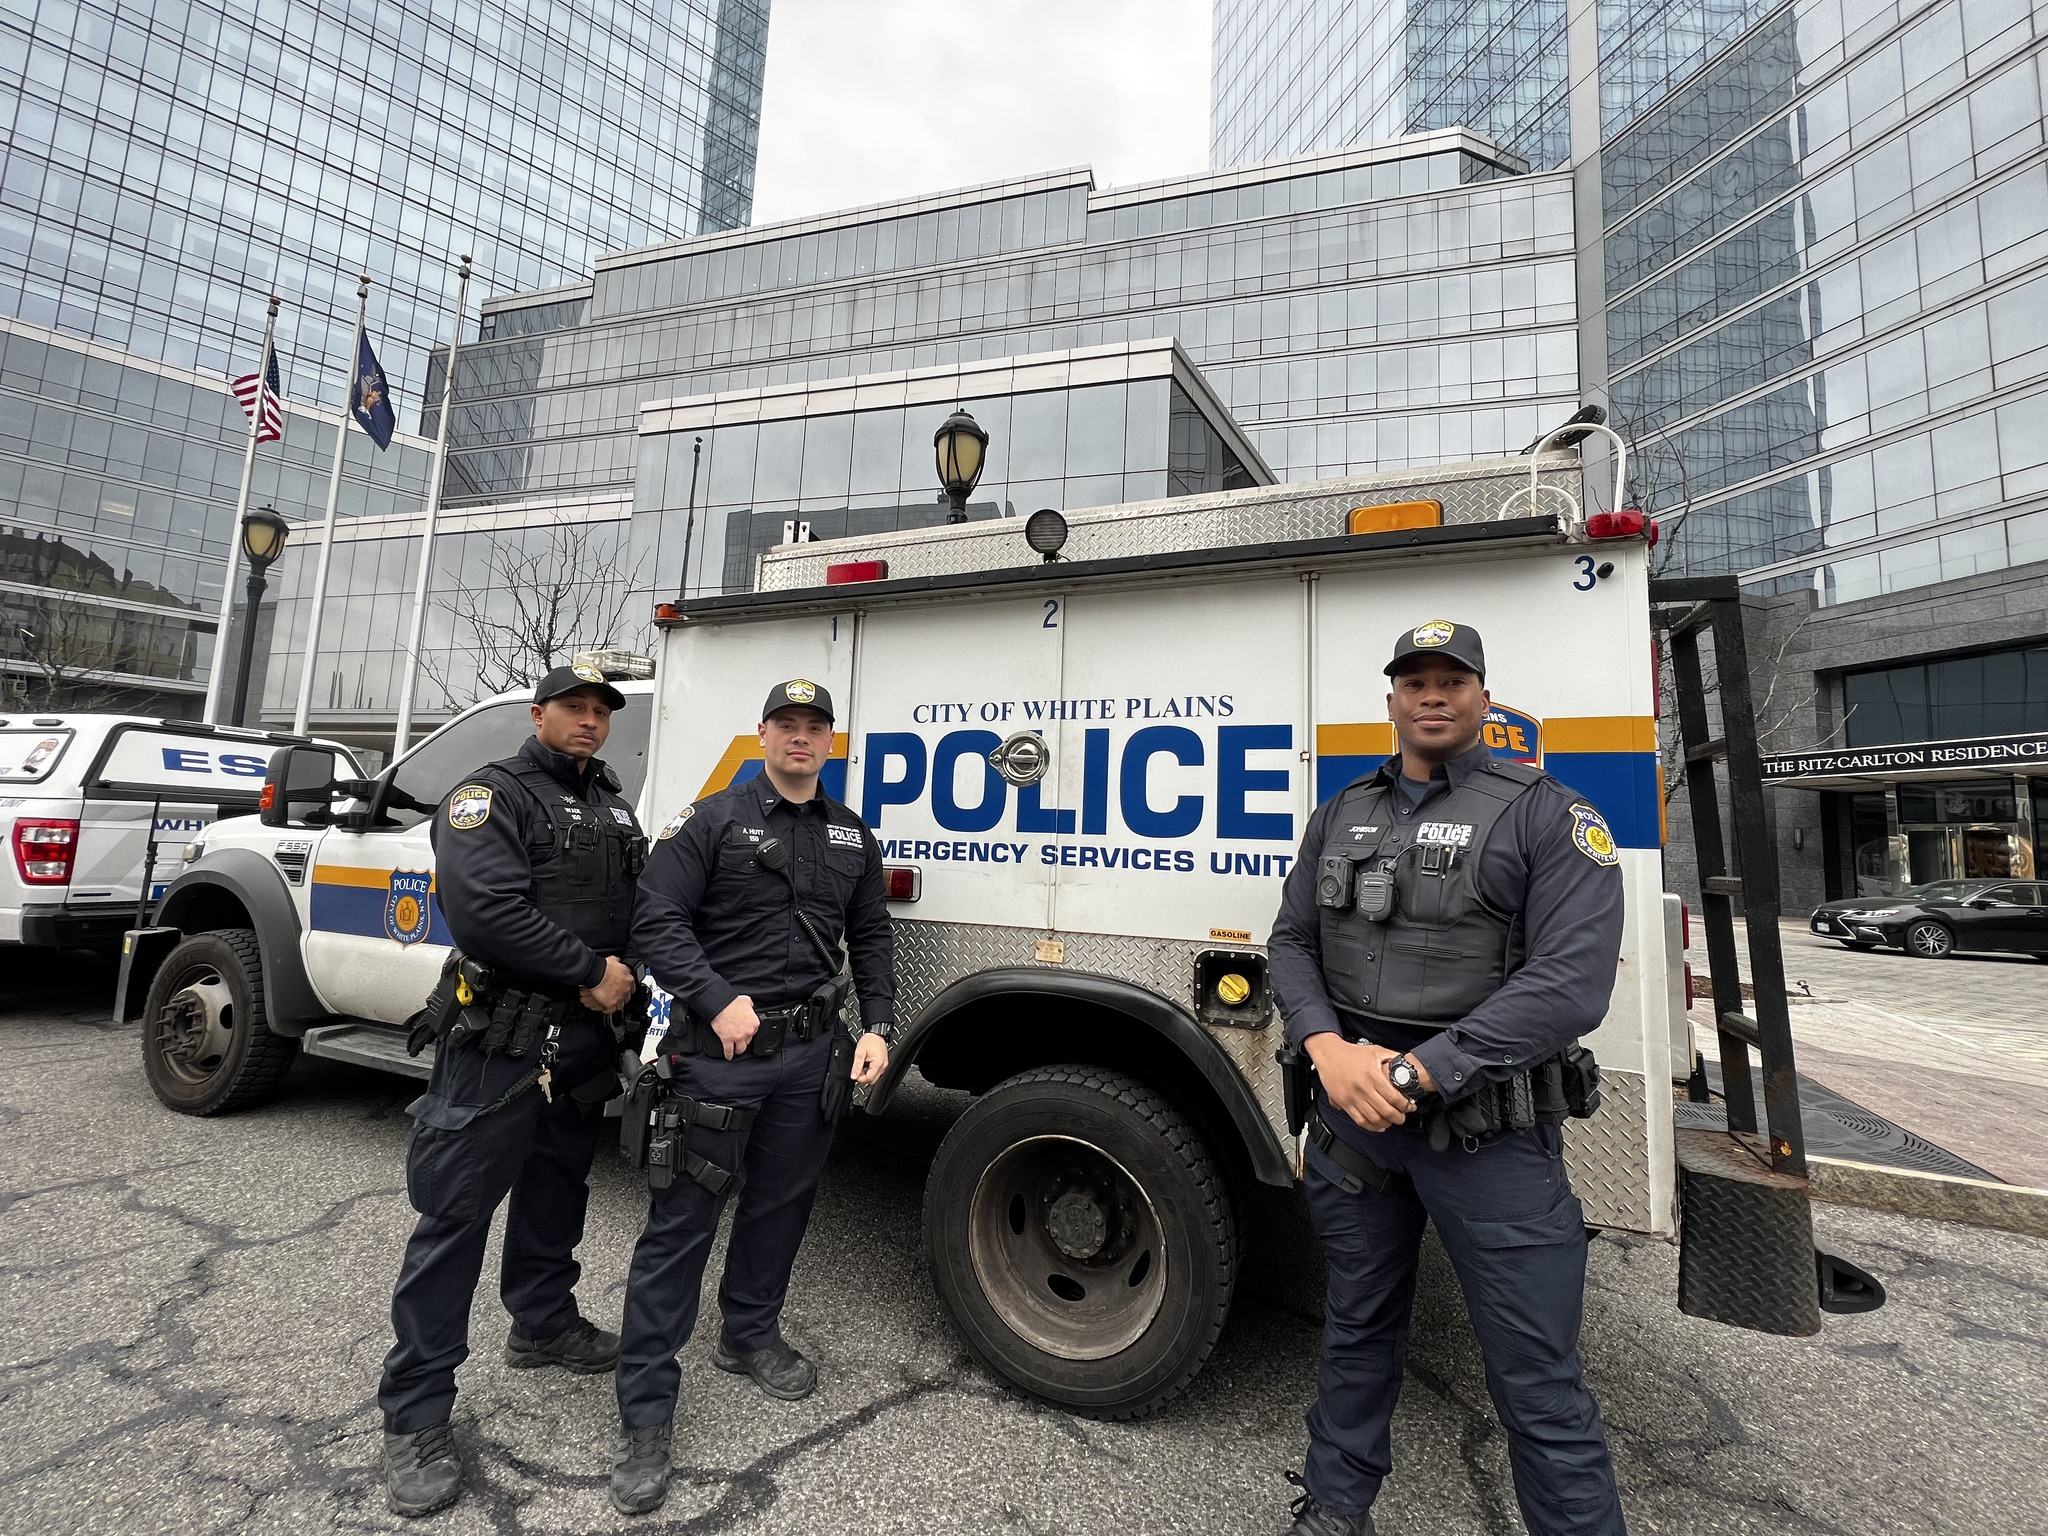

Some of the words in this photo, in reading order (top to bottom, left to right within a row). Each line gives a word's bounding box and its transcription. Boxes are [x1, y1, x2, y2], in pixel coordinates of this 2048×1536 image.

[1573, 555, 1597, 592] 3
[1042, 599, 1059, 629] 2
[832, 615, 838, 642] 1
[912, 702, 974, 724] CITY
[980, 701, 1015, 722] OF
[1022, 698, 1117, 721] WHITE
[1124, 694, 1235, 719] PLAINS
[161, 747, 267, 778] ES
[1762, 761, 1795, 774] THE
[1798, 750, 1925, 772] RITZ-CARLTON
[862, 723, 1294, 841] POLICE
[748, 828, 765, 836] HUTT
[828, 828, 863, 844] POLICE
[1417, 826, 1472, 842] POLICE
[877, 838, 1030, 864] MERGENCY
[1040, 842, 1195, 872] SERVICES
[1209, 851, 1294, 878] UNIT
[393, 878, 428, 893] POLICE
[1210, 930, 1251, 940] GASOLINE
